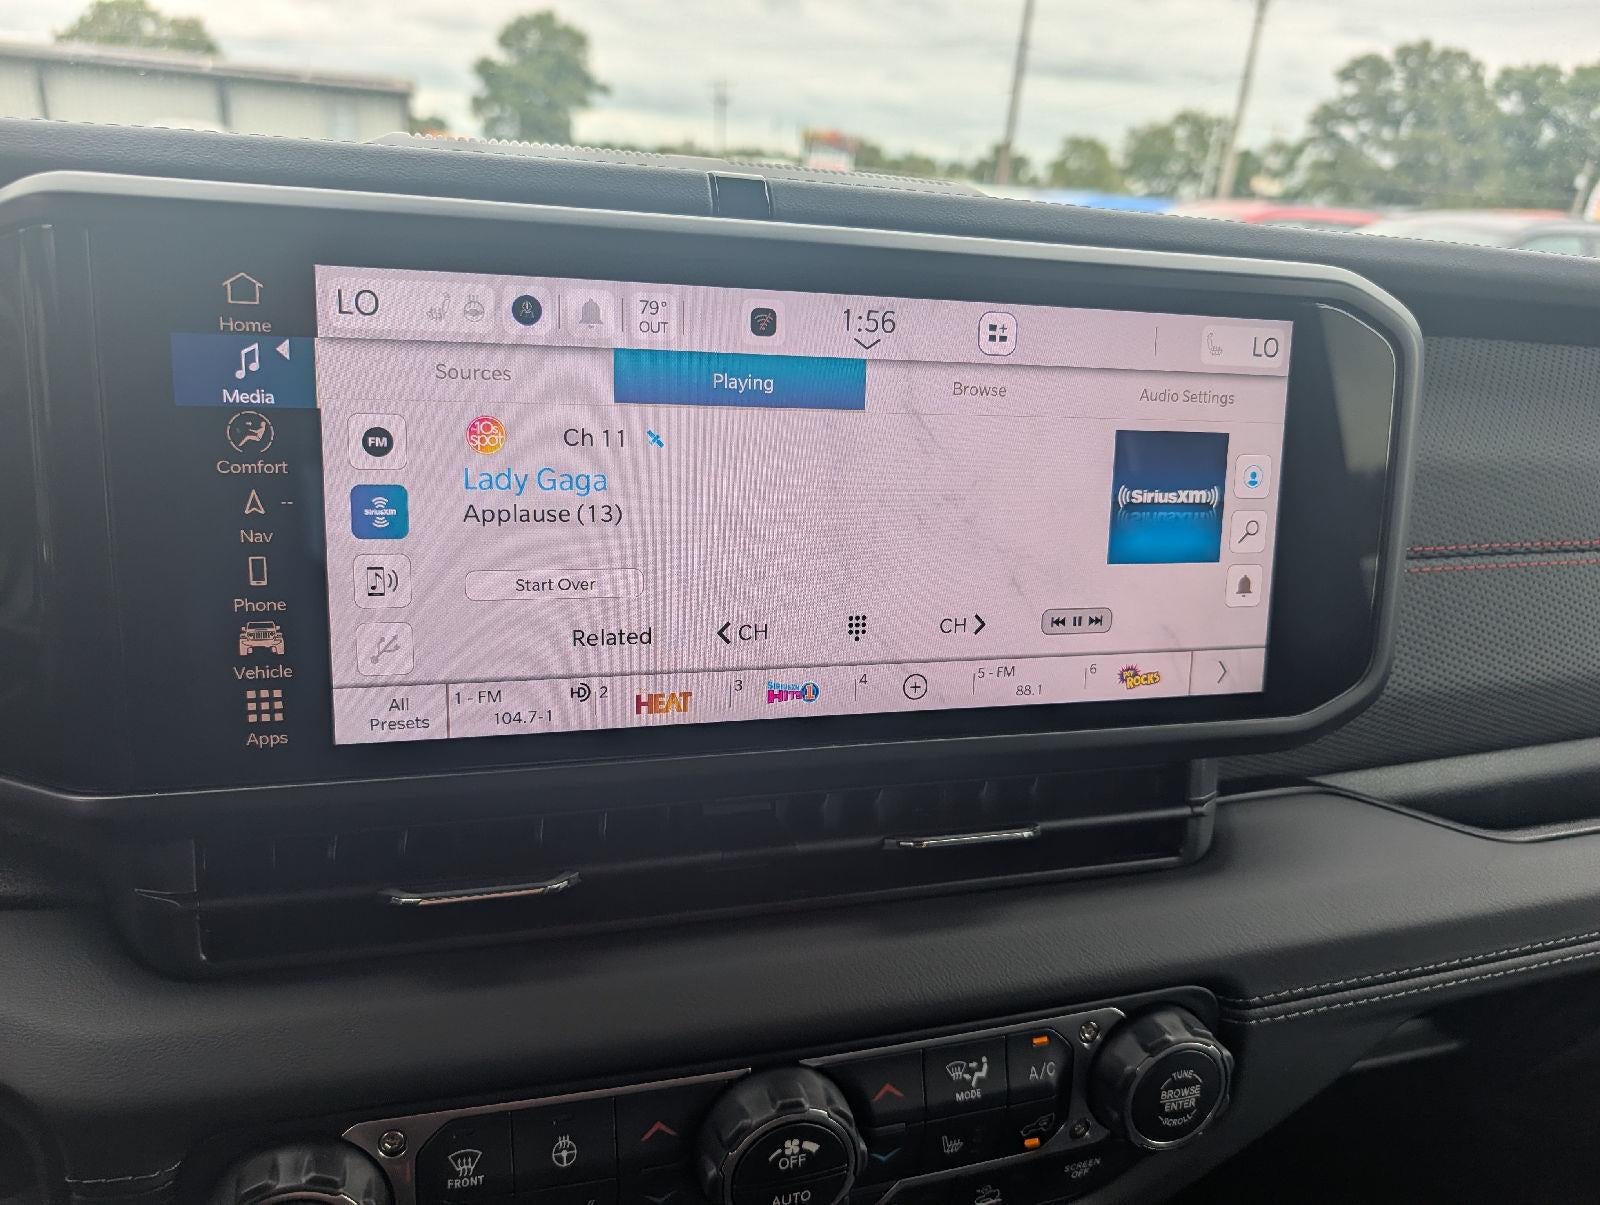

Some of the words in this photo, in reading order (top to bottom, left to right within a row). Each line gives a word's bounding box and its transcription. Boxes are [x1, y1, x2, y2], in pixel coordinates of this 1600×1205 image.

[337, 288, 379, 316] LO
[639, 299, 668, 315] 79°
[219, 317, 272, 333] Home
[639, 320, 669, 334] OUT
[843, 307, 897, 334] 1:56
[1252, 336, 1280, 359] LO
[435, 363, 512, 381] Sources
[712, 373, 775, 394] Playing
[952, 381, 1007, 398] Browse
[222, 388, 275, 405] Media
[1139, 388, 1179, 404] Audio
[1182, 390, 1235, 407] Settings
[368, 436, 388, 448] FM
[563, 428, 594, 447] Ch
[602, 429, 625, 447] 11
[216, 459, 288, 474] Comfort
[463, 467, 529, 496] Lady
[536, 467, 608, 496] Gaga
[463, 504, 571, 527] Applause
[577, 504, 623, 526] (13)
[240, 529, 273, 543] Nav
[515, 578, 554, 592] Start
[557, 578, 596, 592] Over
[234, 598, 287, 612] Phone
[738, 624, 768, 641] CH
[939, 618, 967, 634] CH
[572, 626, 652, 647] Related
[233, 665, 293, 680] Vehicle
[977, 668, 985, 679] 5
[996, 666, 1016, 678] FM
[1089, 663, 1097, 675] 6
[734, 680, 743, 692] 3
[859, 673, 868, 686] 4
[1126, 672, 1161, 690] ROCKS
[455, 692, 461, 704] 1
[478, 690, 502, 704] FM
[599, 685, 608, 699] 2
[1015, 685, 1042, 697] 88.1
[388, 698, 409, 711] All
[635, 691, 692, 715] HEAT
[370, 717, 430, 731] Presets
[494, 710, 553, 725] 104.7-1
[246, 732, 289, 749] Apps
[1028, 1061, 1057, 1081] A/C
[1171, 1069, 1195, 1080] TUNE
[955, 1088, 982, 1102] MODE
[1160, 1084, 1201, 1101] BROWSE
[1164, 1097, 1196, 1112] ENTER
[778, 1152, 807, 1170] OFF
[447, 1175, 485, 1190] FRONT
[772, 1189, 811, 1205] AUTO
